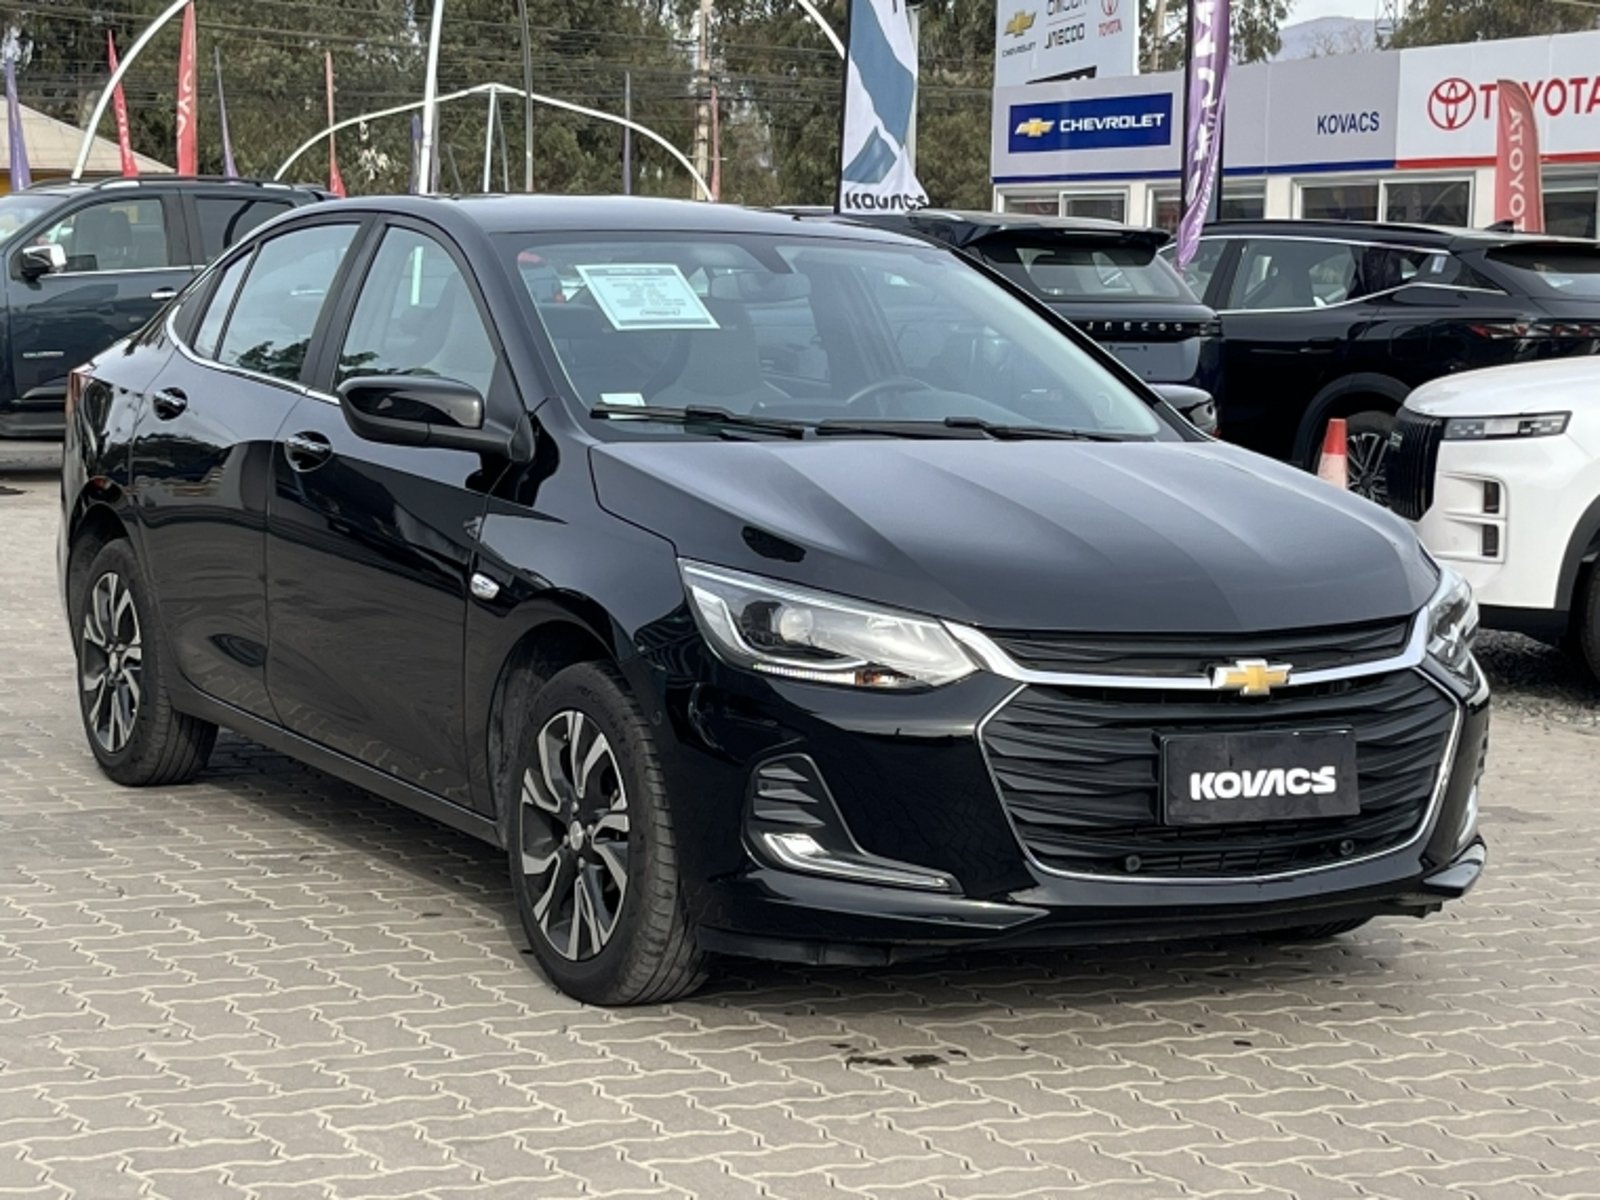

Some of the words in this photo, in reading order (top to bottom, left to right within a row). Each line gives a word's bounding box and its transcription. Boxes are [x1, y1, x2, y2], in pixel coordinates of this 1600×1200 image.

[1479, 76, 1600, 119] TYOTA
[1060, 113, 1165, 132] CHEVROLET
[1317, 111, 1379, 135] KOVACS
[1190, 766, 1336, 800] KOVACS
